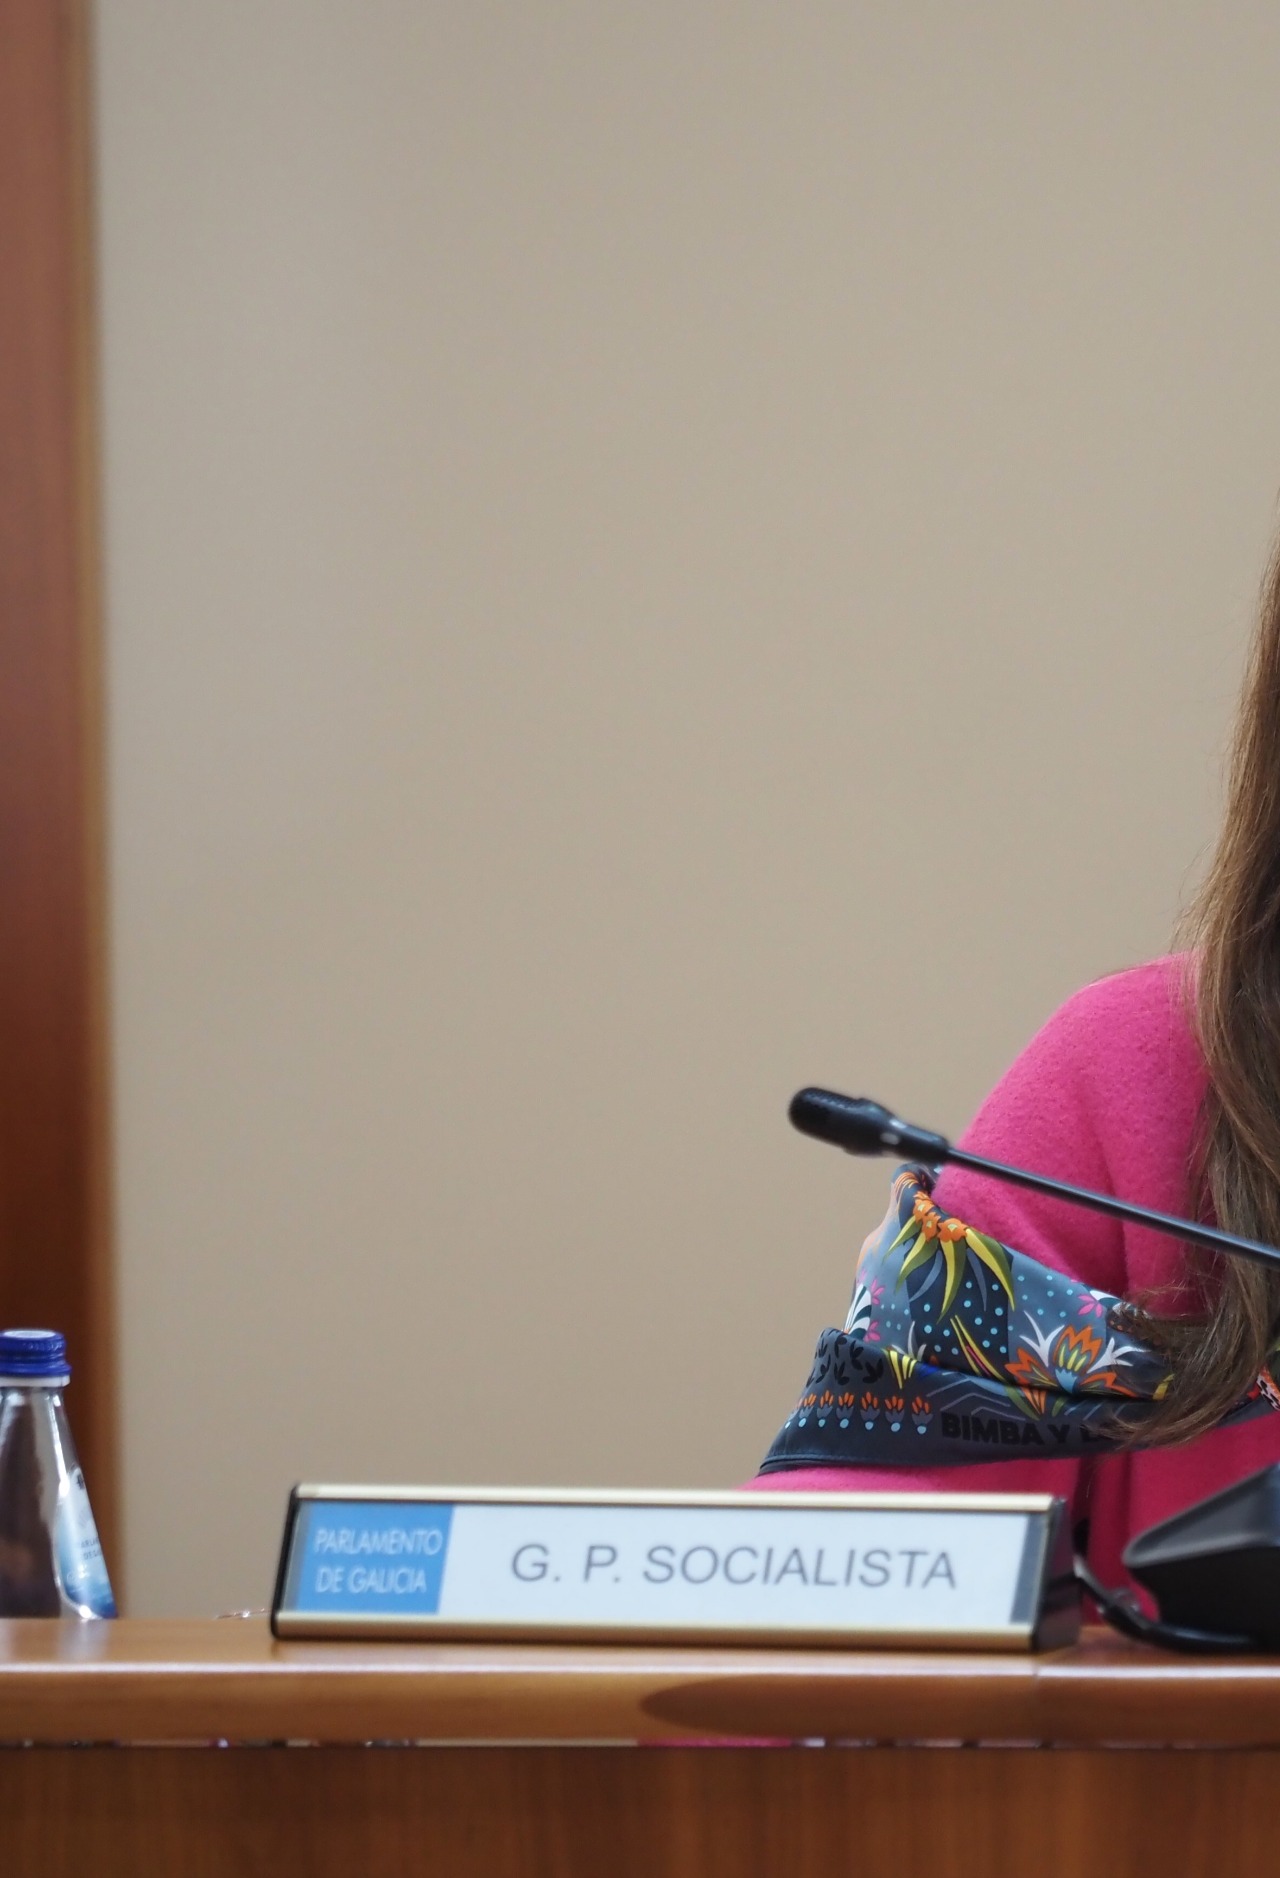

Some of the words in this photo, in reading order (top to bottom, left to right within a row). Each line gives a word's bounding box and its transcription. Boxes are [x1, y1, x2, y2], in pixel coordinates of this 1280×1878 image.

[941, 1413, 1044, 1445] BIMBA
[1047, 1424, 1070, 1445] Y
[315, 1528, 444, 1555] PARLAMENTO
[315, 1566, 344, 1593] DE
[348, 1566, 427, 1594] GALICIA
[511, 1543, 561, 1582] G.
[583, 1544, 621, 1583] P.
[643, 1545, 956, 1589] SOCIALISTA
